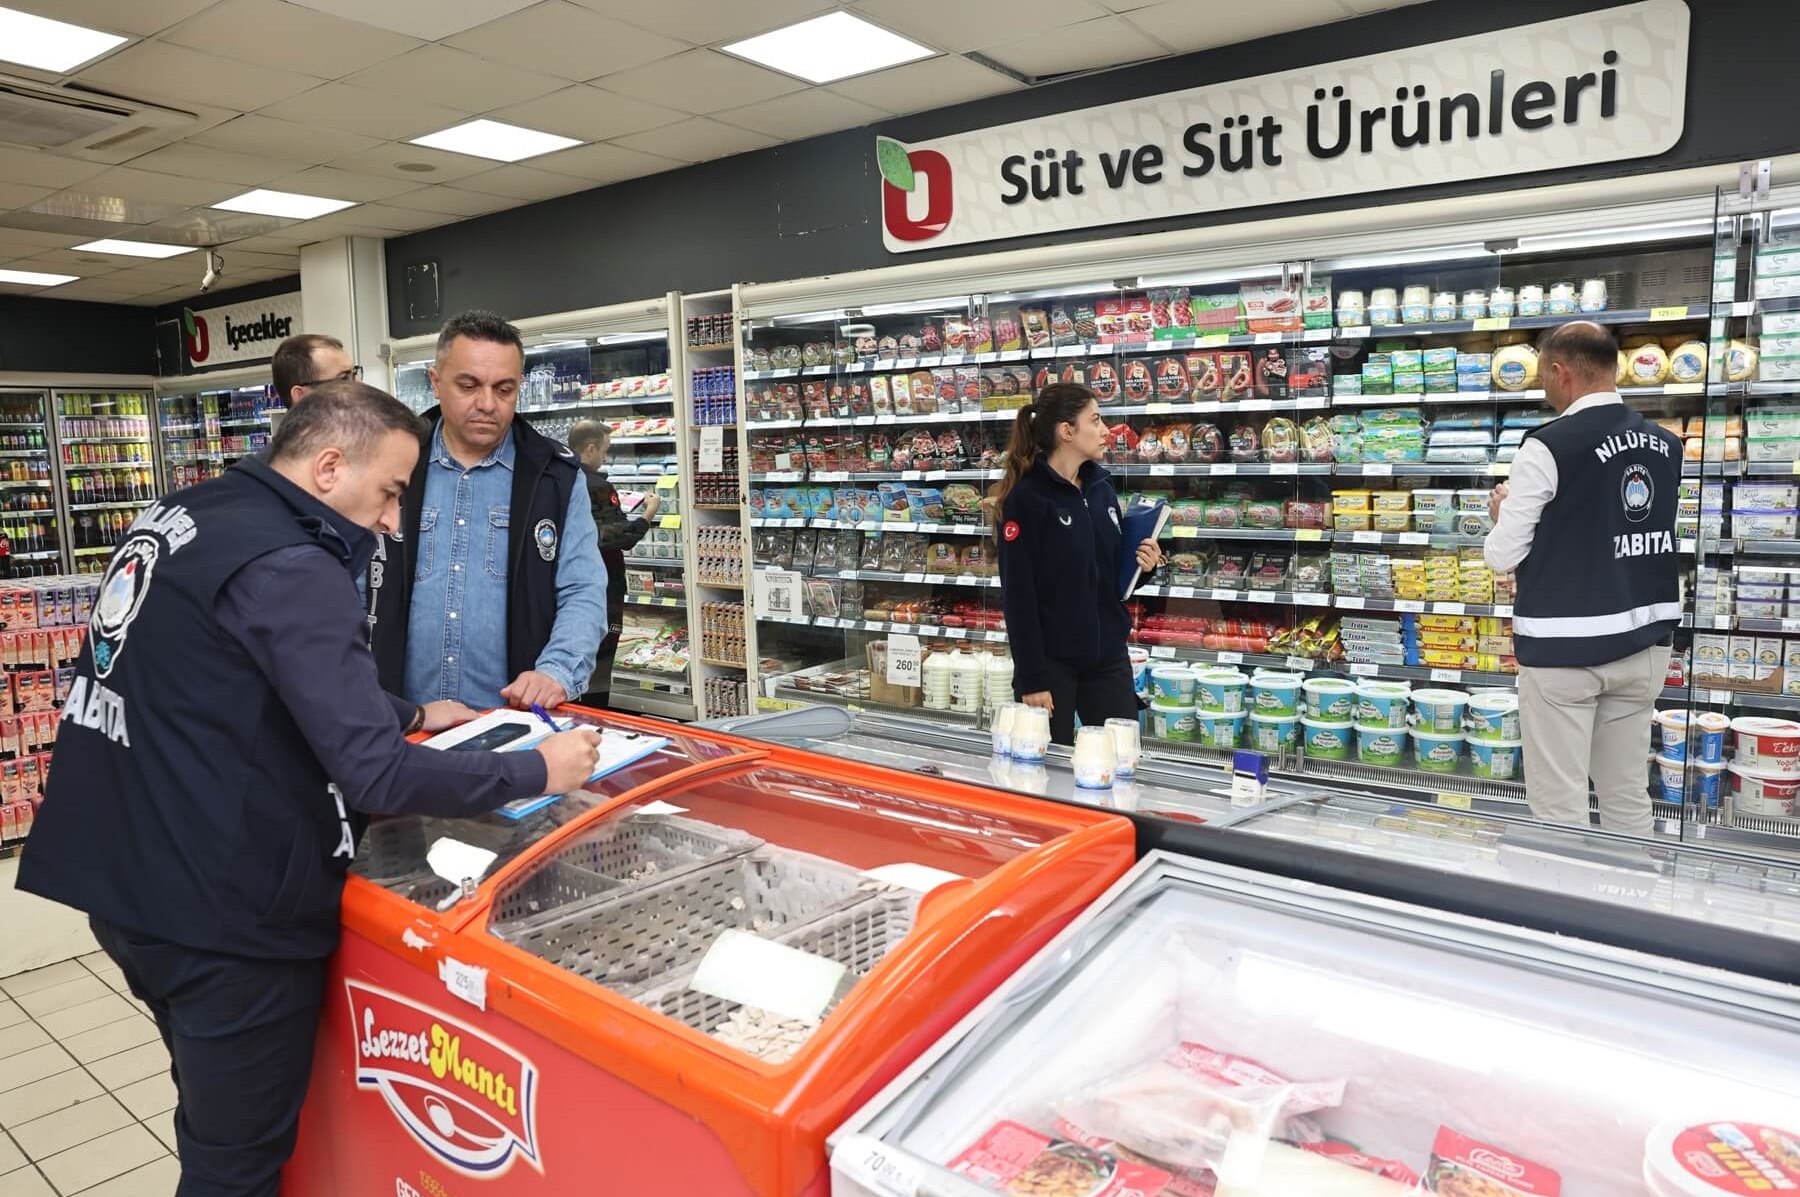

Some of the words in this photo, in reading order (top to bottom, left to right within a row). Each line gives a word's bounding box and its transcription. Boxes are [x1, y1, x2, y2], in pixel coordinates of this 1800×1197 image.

[1001, 137, 1084, 205] Süt
[1102, 139, 1164, 190] ve
[1183, 114, 1282, 178] Süt
[1306, 50, 1619, 159] Ürünleri
[225, 315, 292, 351] İçecekler
[1595, 430, 1669, 463] NİLÜFER
[1614, 530, 1673, 559] ZABITA
[896, 660, 912, 671] 260
[362, 1007, 430, 1066] Lezzet
[429, 1024, 517, 1116] Mantı
